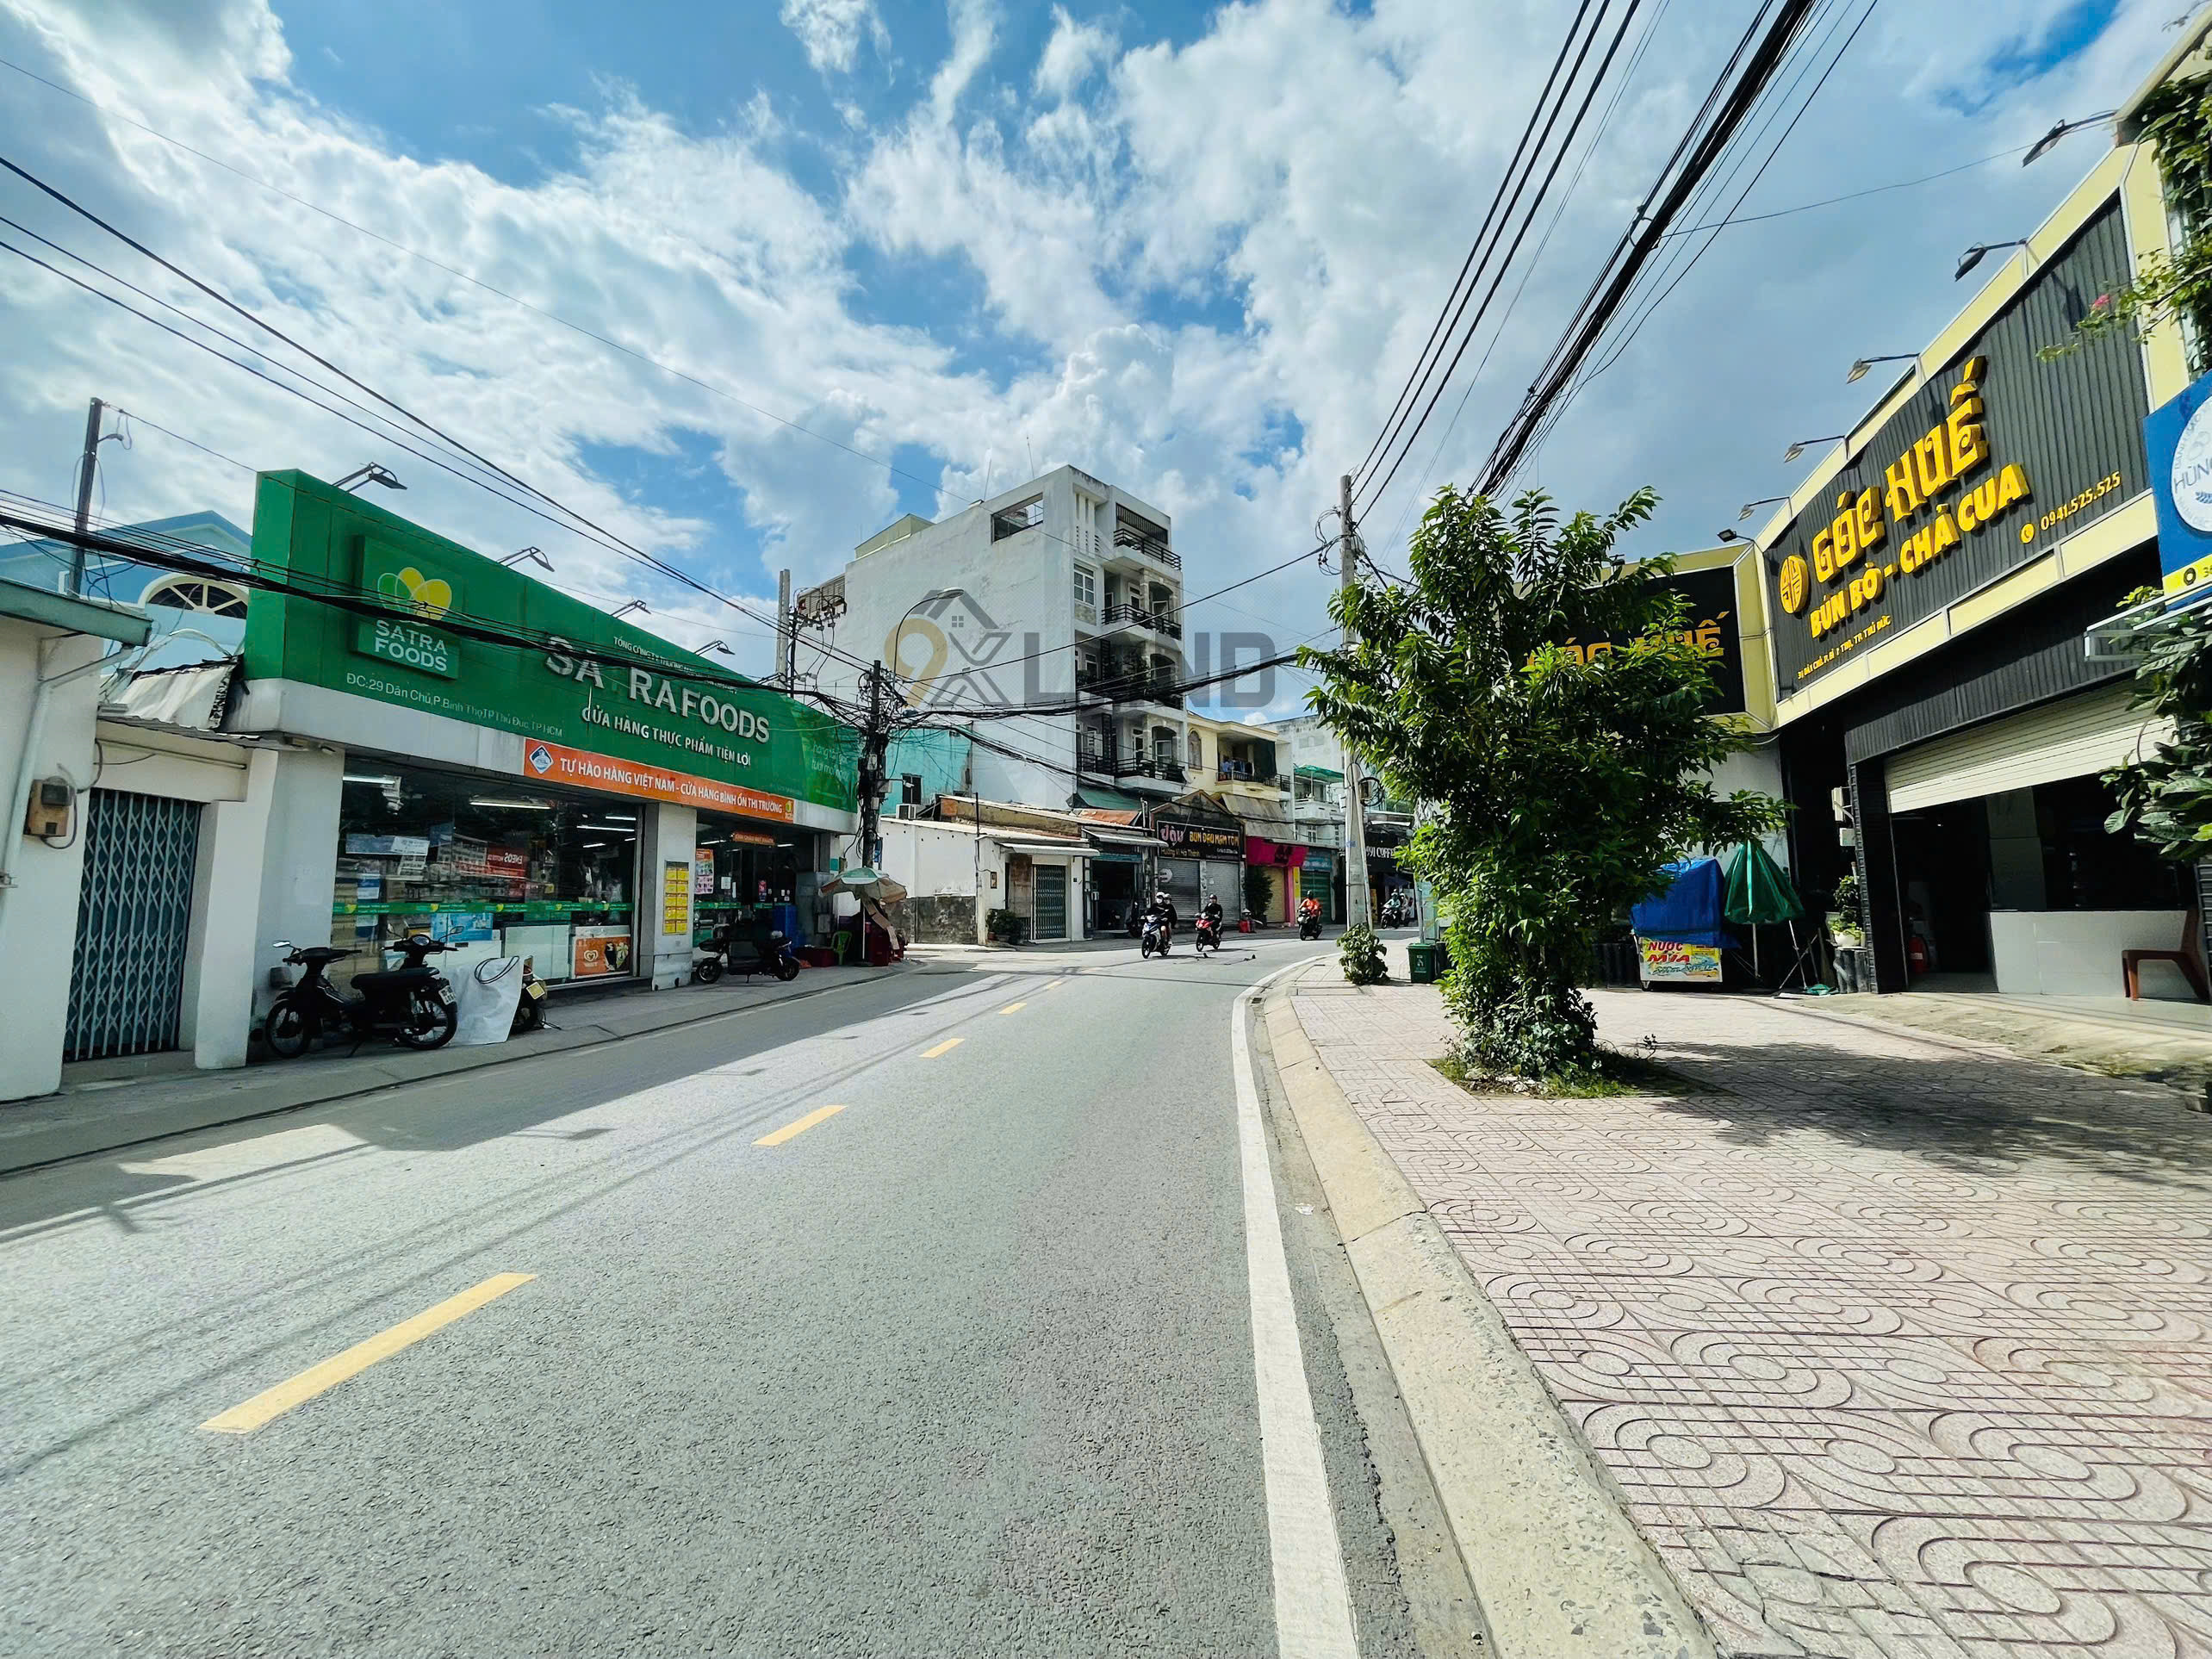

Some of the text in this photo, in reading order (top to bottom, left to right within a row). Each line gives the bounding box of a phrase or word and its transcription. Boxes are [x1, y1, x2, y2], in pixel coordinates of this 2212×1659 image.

[1811, 356, 1988, 583] GÓC HUẾ
[2174, 455, 2212, 494] HÙN
[2040, 470, 2121, 531] 0941.525.525
[1811, 595, 1850, 638] BÚN
[1849, 562, 1884, 611] BÒ
[1899, 504, 1961, 574] CHẢ
[1957, 463, 2030, 532] CUA
[374, 637, 448, 672] FOODS
[376, 619, 449, 656] SATRA
[386, 682, 408, 699] Dân
[614, 716, 649, 739] HÀNG
[652, 727, 681, 749] THỰC
[685, 735, 713, 756] PHẨM
[717, 746, 735, 764] TIỆN
[736, 752, 751, 768] LỢI
[560, 758, 577, 777] TỰ
[578, 761, 601, 777] HÀO
[604, 765, 632, 785] HÀNG
[633, 772, 654, 791] VIỆT
[655, 777, 675, 793] NAM
[680, 781, 697, 798] CỬA
[698, 786, 719, 801] HÀNG
[719, 791, 736, 806] BÌNH
[737, 792, 748, 807] ỔN
[748, 798, 758, 811] THỊ
[758, 799, 783, 814] TRƯỜNG
